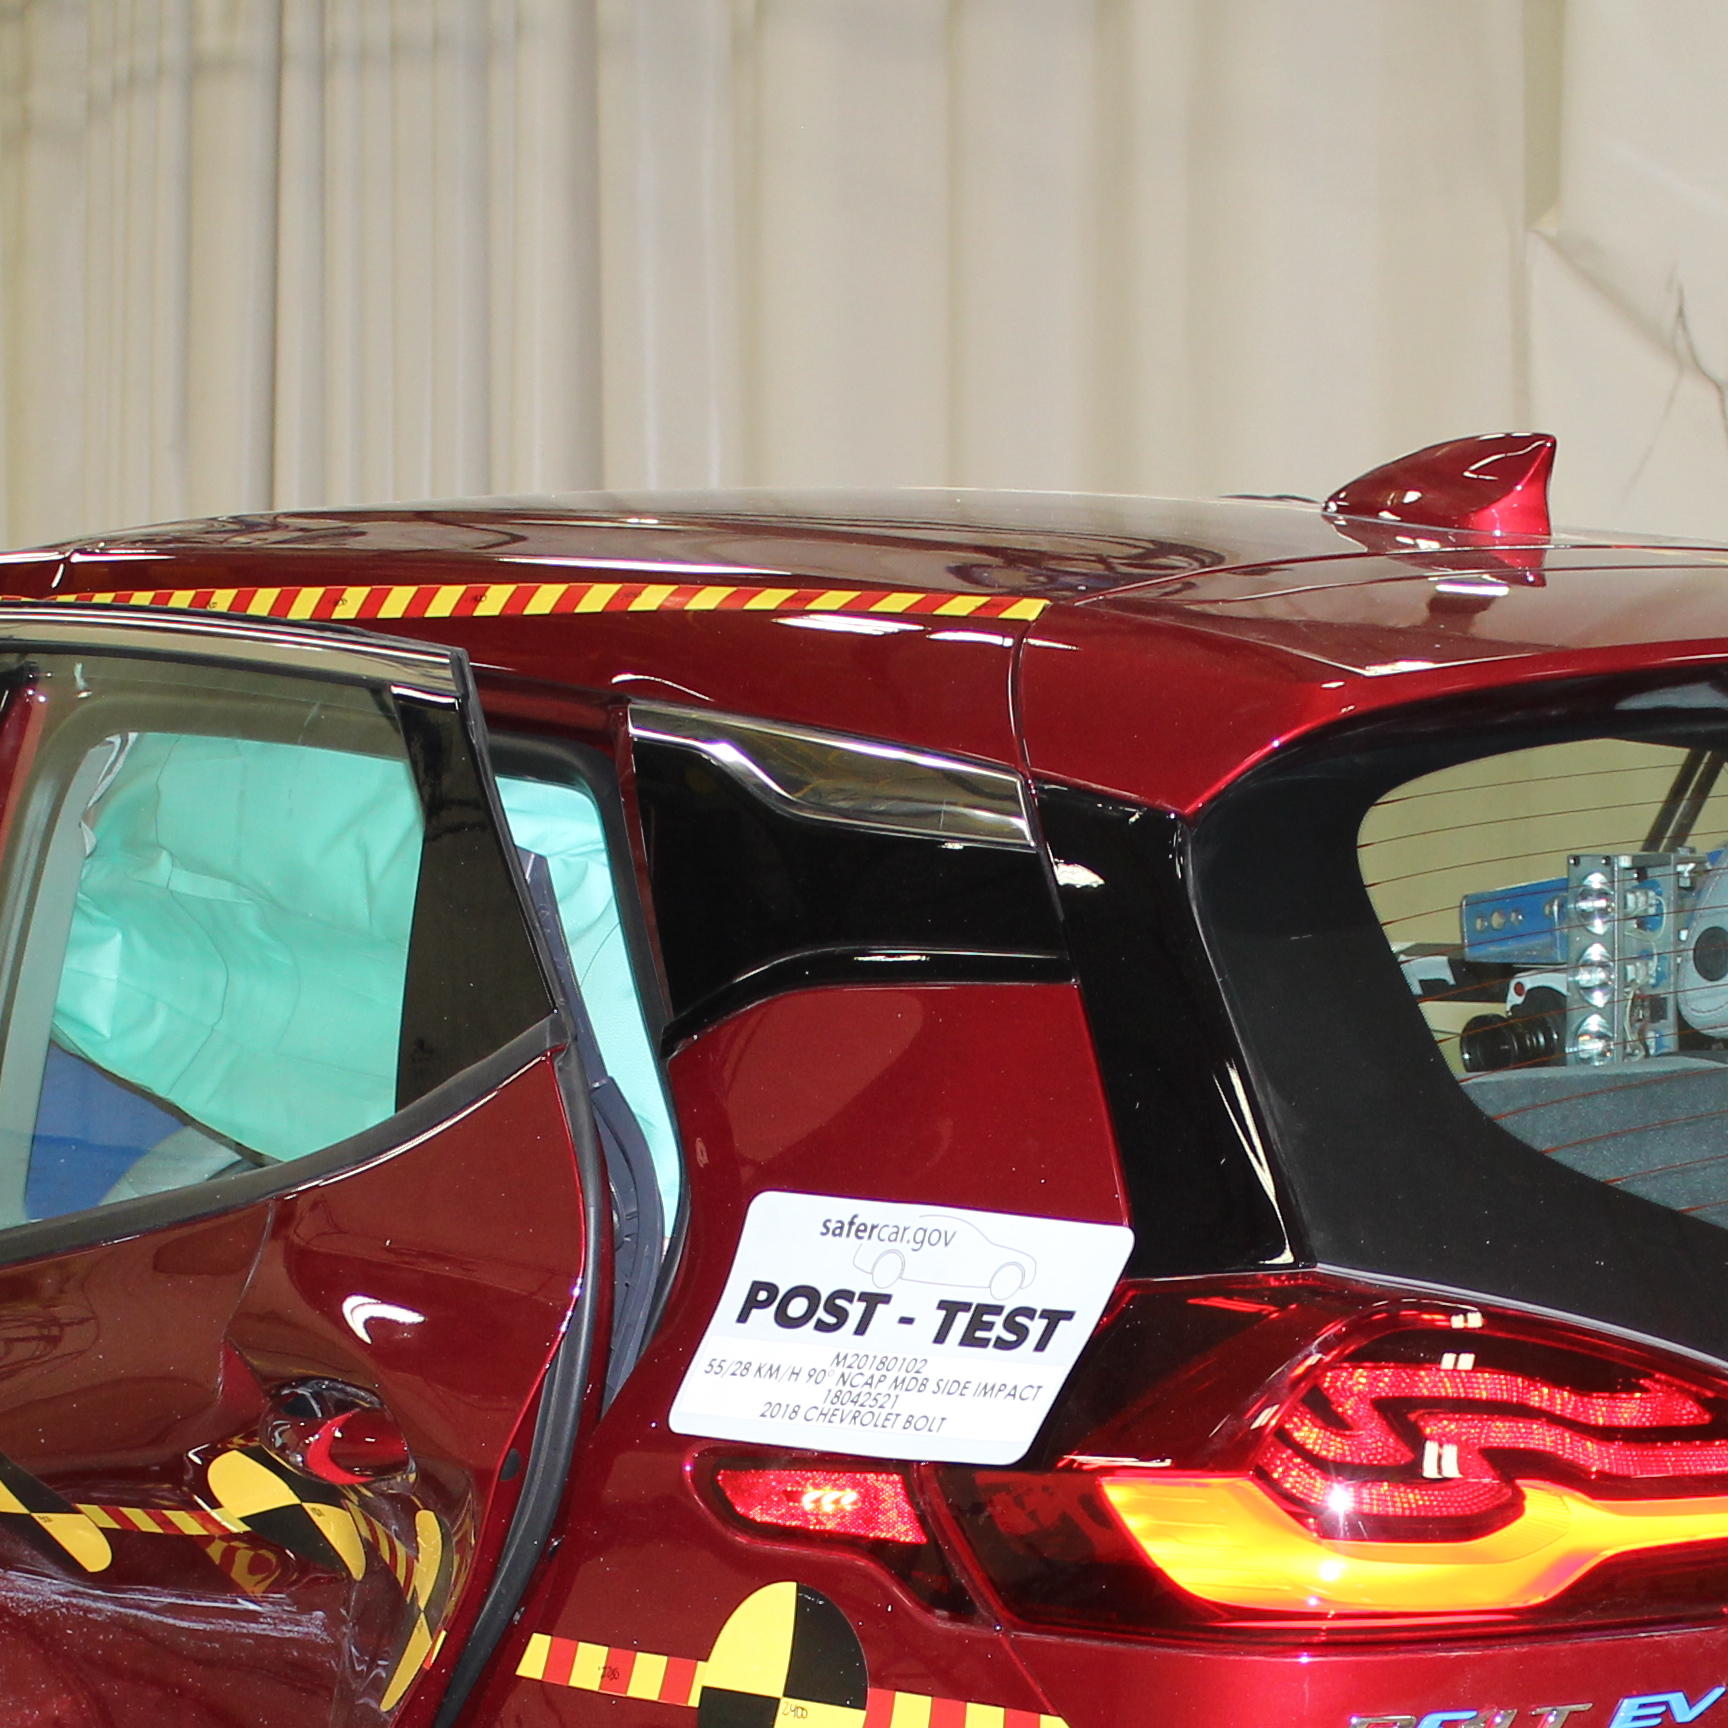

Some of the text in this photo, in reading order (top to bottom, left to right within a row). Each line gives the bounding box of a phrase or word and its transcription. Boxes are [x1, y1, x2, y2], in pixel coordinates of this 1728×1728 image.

[820, 1214, 956, 1250] safercar.gov
[735, 1280, 892, 1336] POST
[932, 1299, 1076, 1353] TEST
[830, 1351, 928, 1374] M20180102
[704, 1358, 752, 1378] 55/28
[753, 1362, 802, 1383] KM/H
[835, 1371, 887, 1390] NCAP
[888, 1375, 929, 1393] MDB
[932, 1378, 972, 1397] SIDE
[972, 1381, 1043, 1401] IMPACT
[823, 1388, 900, 1409] 18042521
[759, 1401, 947, 1433] 2018 CHEVROLET BOLT
[781, 1700, 808, 1719] 2400
